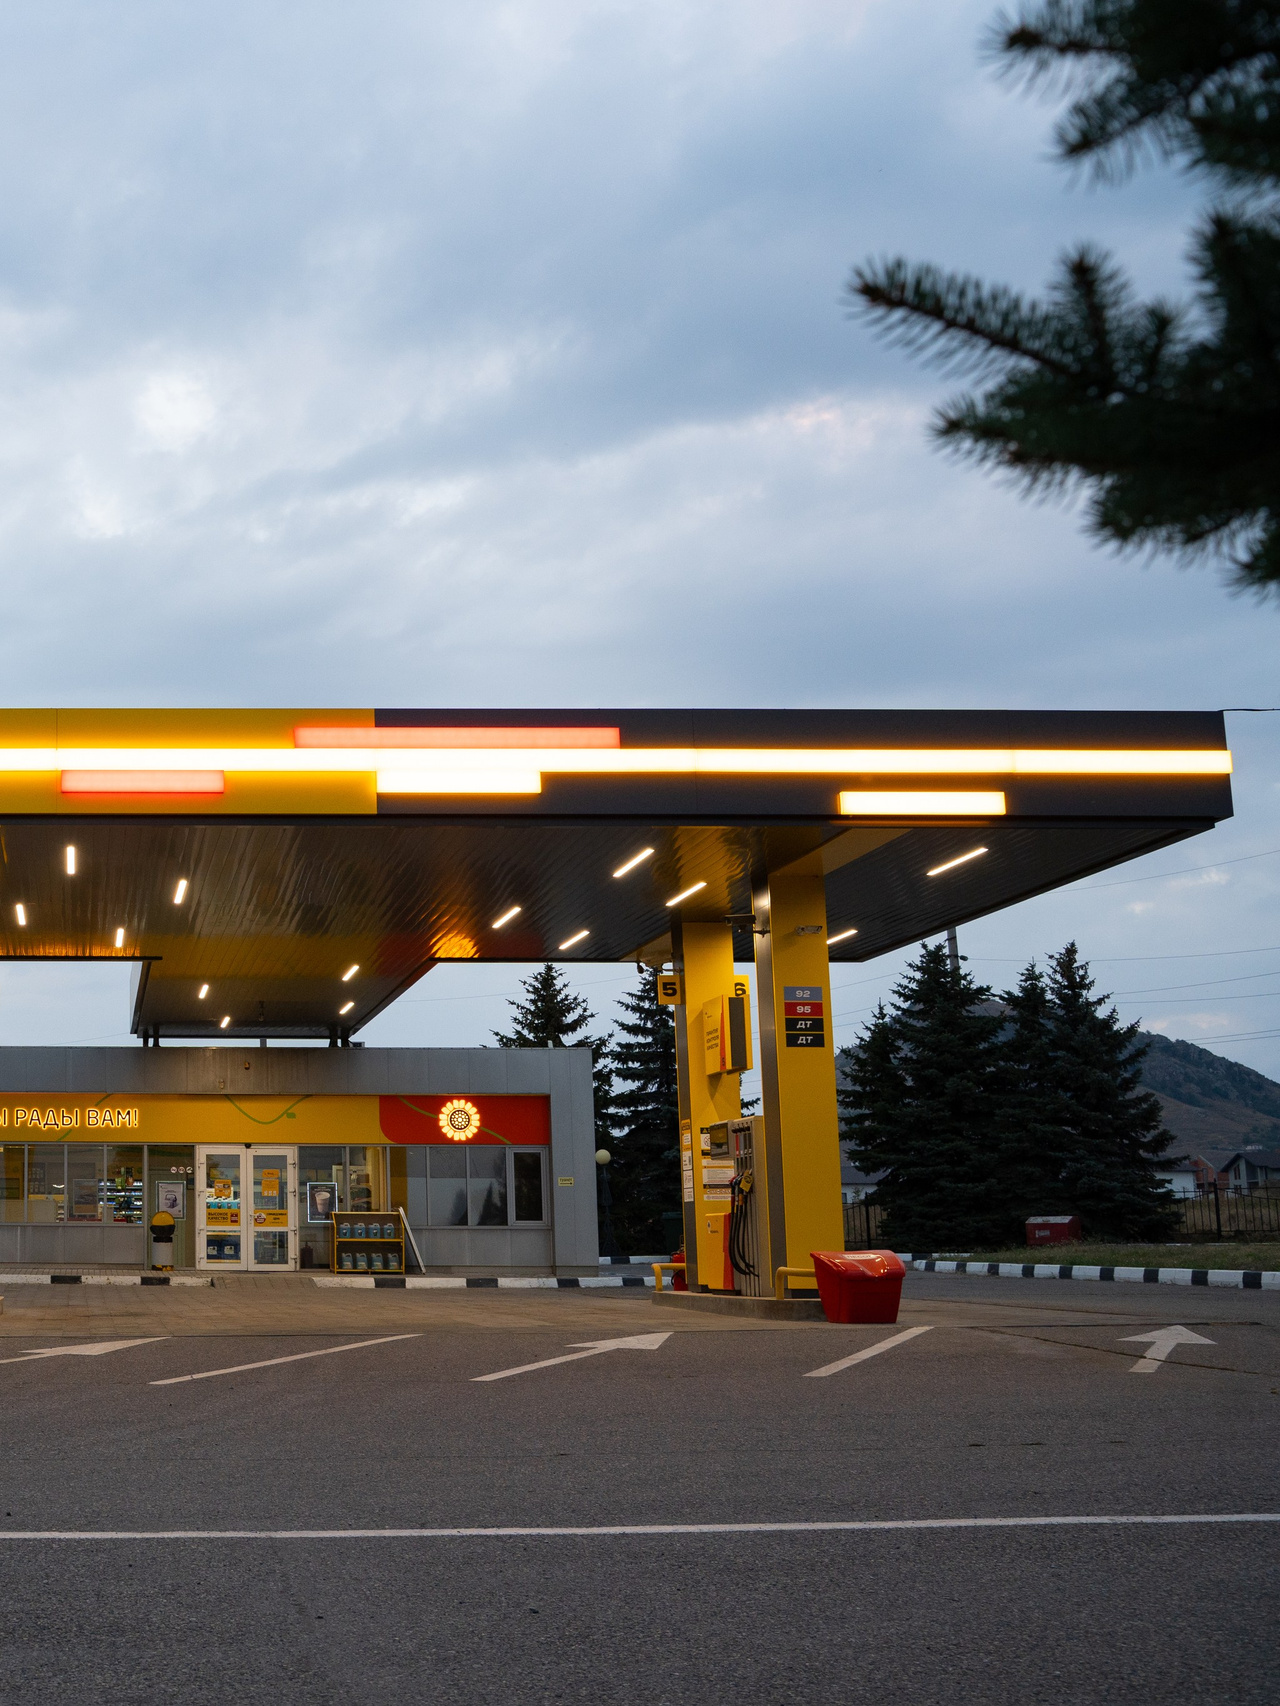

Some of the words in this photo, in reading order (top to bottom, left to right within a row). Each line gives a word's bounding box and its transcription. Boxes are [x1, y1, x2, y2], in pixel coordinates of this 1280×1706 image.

[662, 982, 678, 997] 5
[734, 982, 747, 997] 6
[795, 990, 811, 998] 92
[796, 1005, 812, 1013] 95
[796, 1020, 813, 1029] ДТ
[797, 1036, 813, 1044] ДТ
[14, 1108, 79, 1130] РАДЫ
[86, 1108, 139, 1127] ВАМ!
